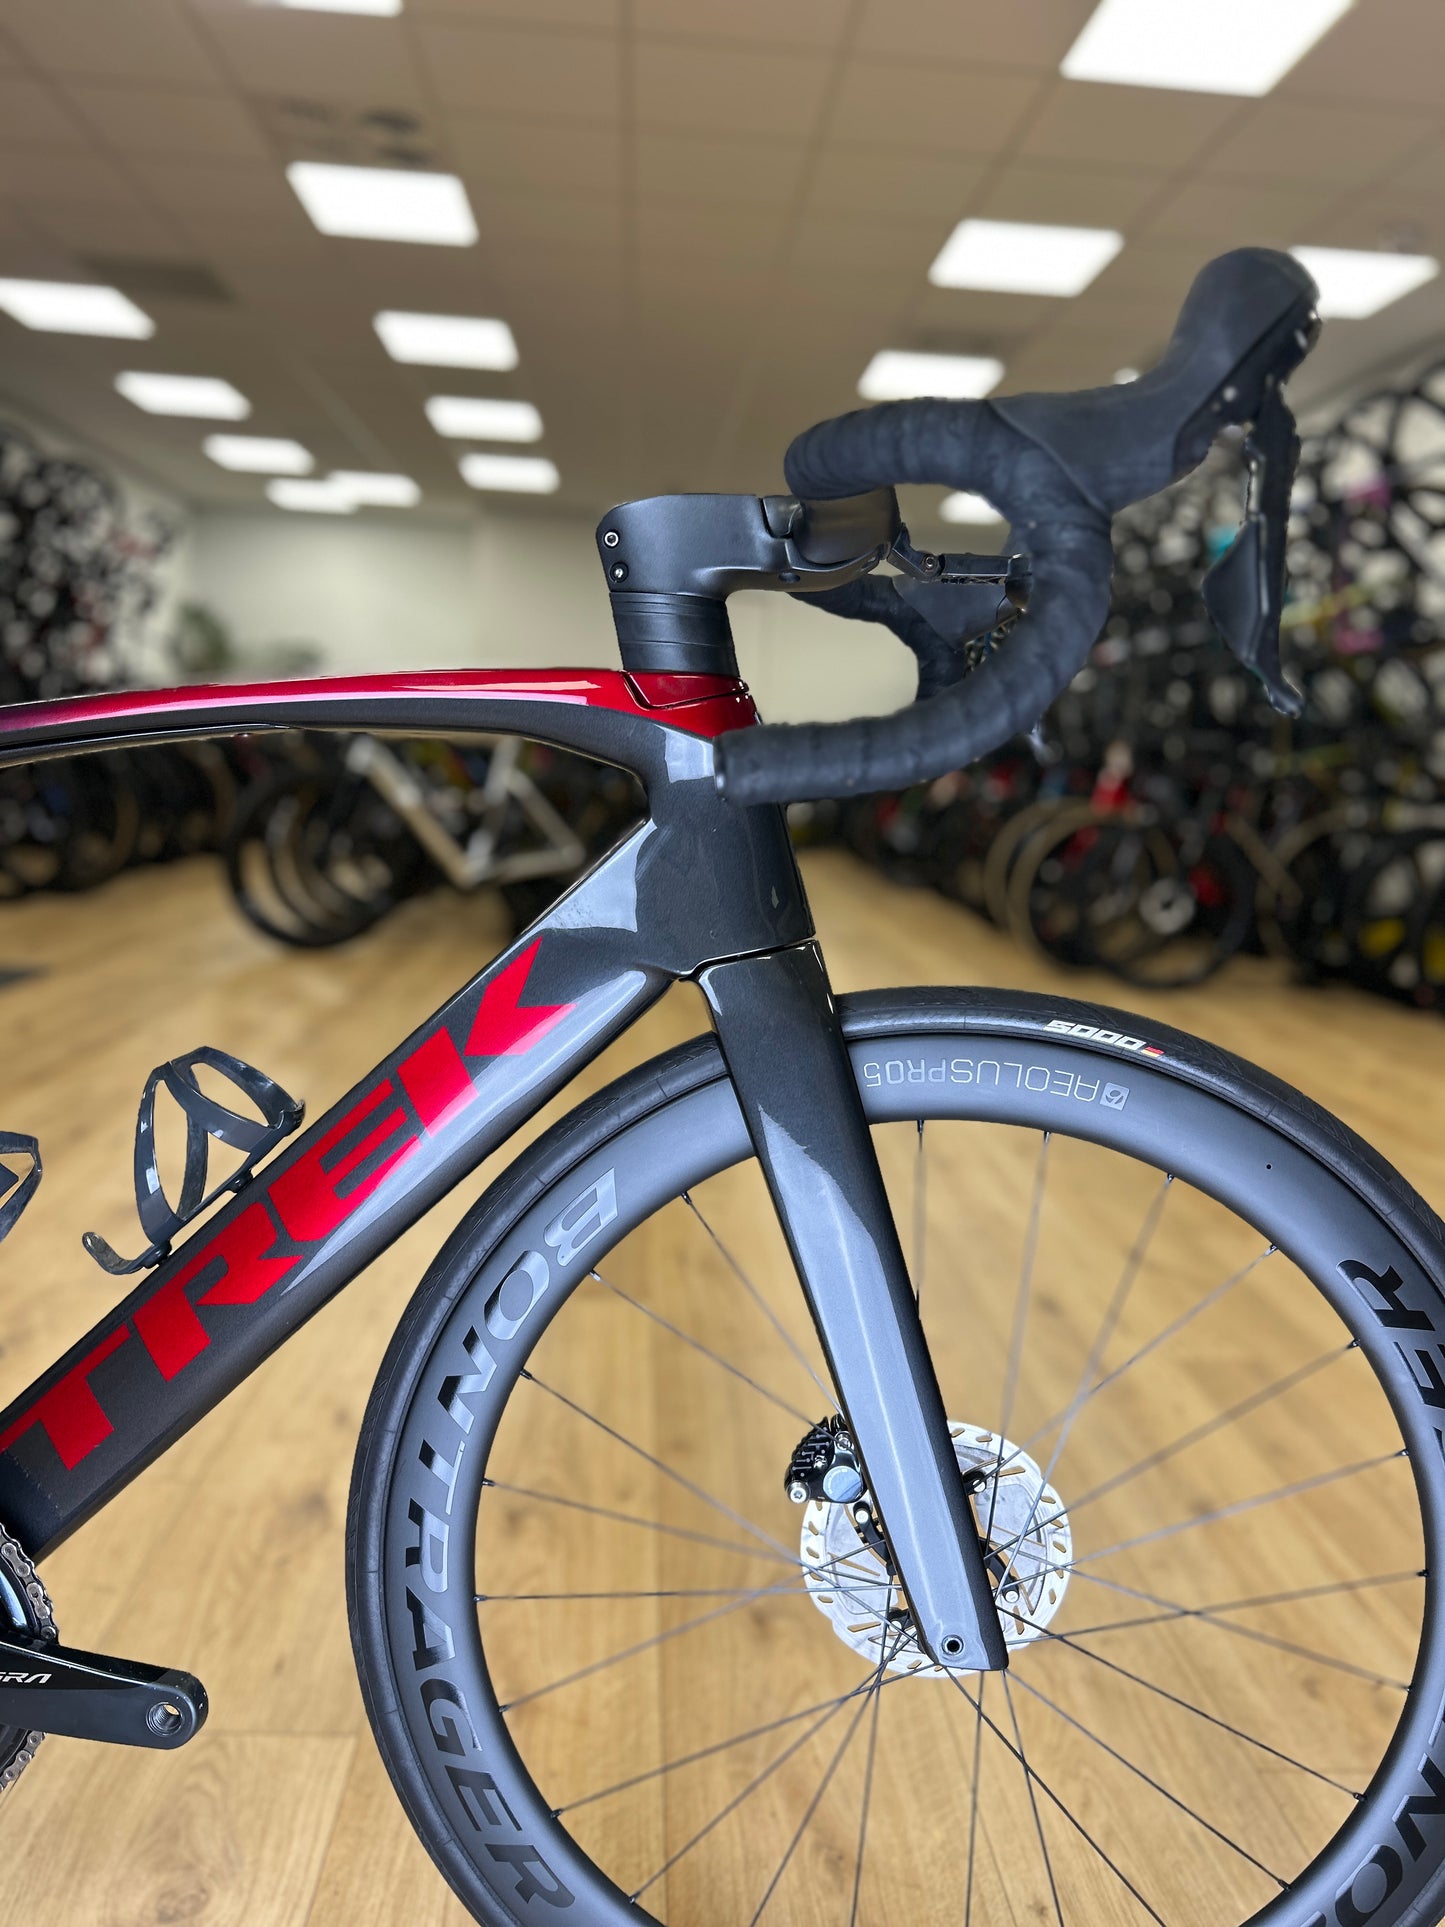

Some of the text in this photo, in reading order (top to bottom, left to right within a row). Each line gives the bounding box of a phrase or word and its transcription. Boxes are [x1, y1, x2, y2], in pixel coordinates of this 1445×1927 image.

[0, 936, 577, 1471] TREK
[1043, 1019, 1146, 1050] 5000
[405, 1168, 618, 1905] BONTRAGER
